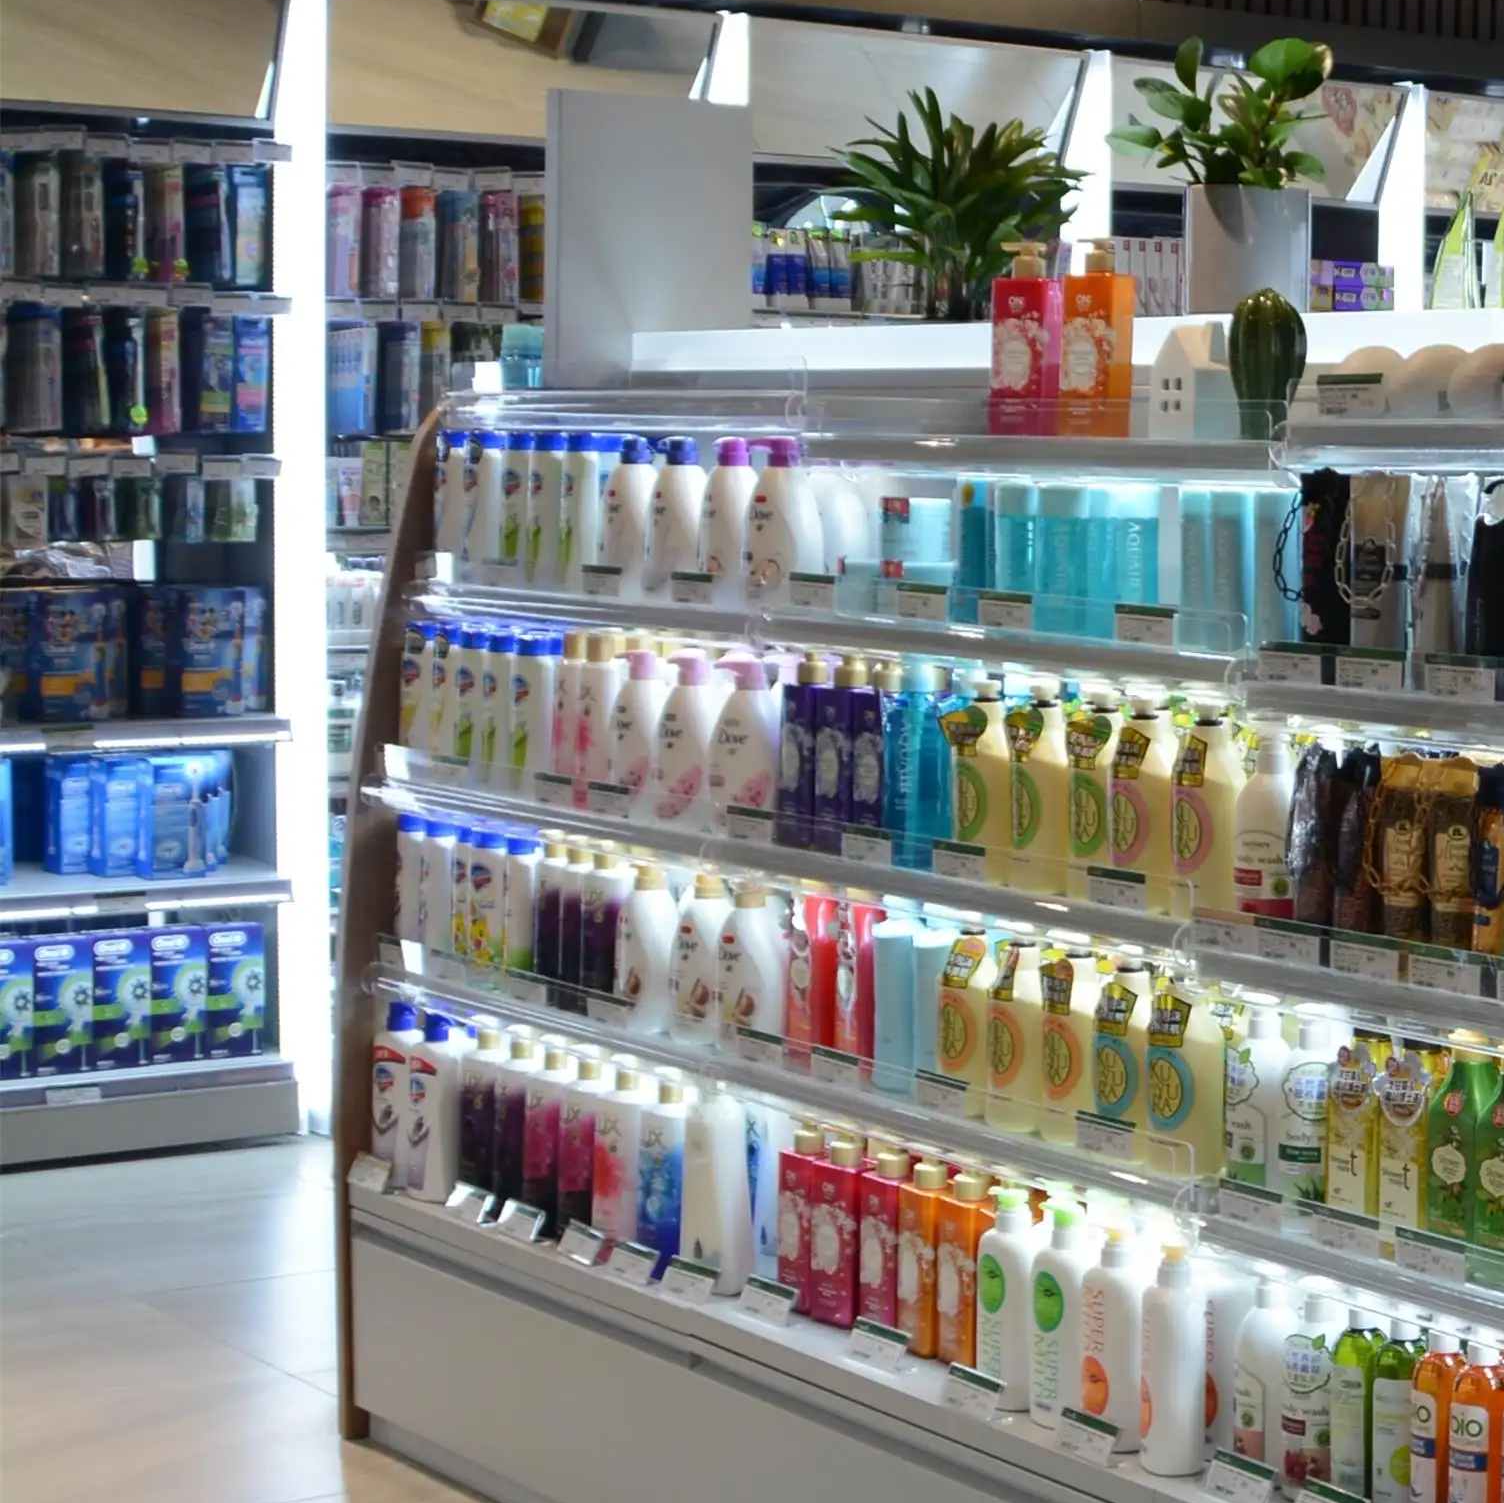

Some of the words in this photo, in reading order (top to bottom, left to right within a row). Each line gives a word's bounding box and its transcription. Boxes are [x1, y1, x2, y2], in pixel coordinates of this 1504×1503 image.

[748, 507, 774, 522] Dove
[717, 728, 749, 746] Dove
[1258, 853, 1284, 865] wash
[678, 936, 699, 952] Dove
[717, 948, 742, 963] Dove
[1285, 1131, 1313, 1146] body
[1092, 1289, 1106, 1354] SUPER
[1046, 1338, 1060, 1401] SUPER
